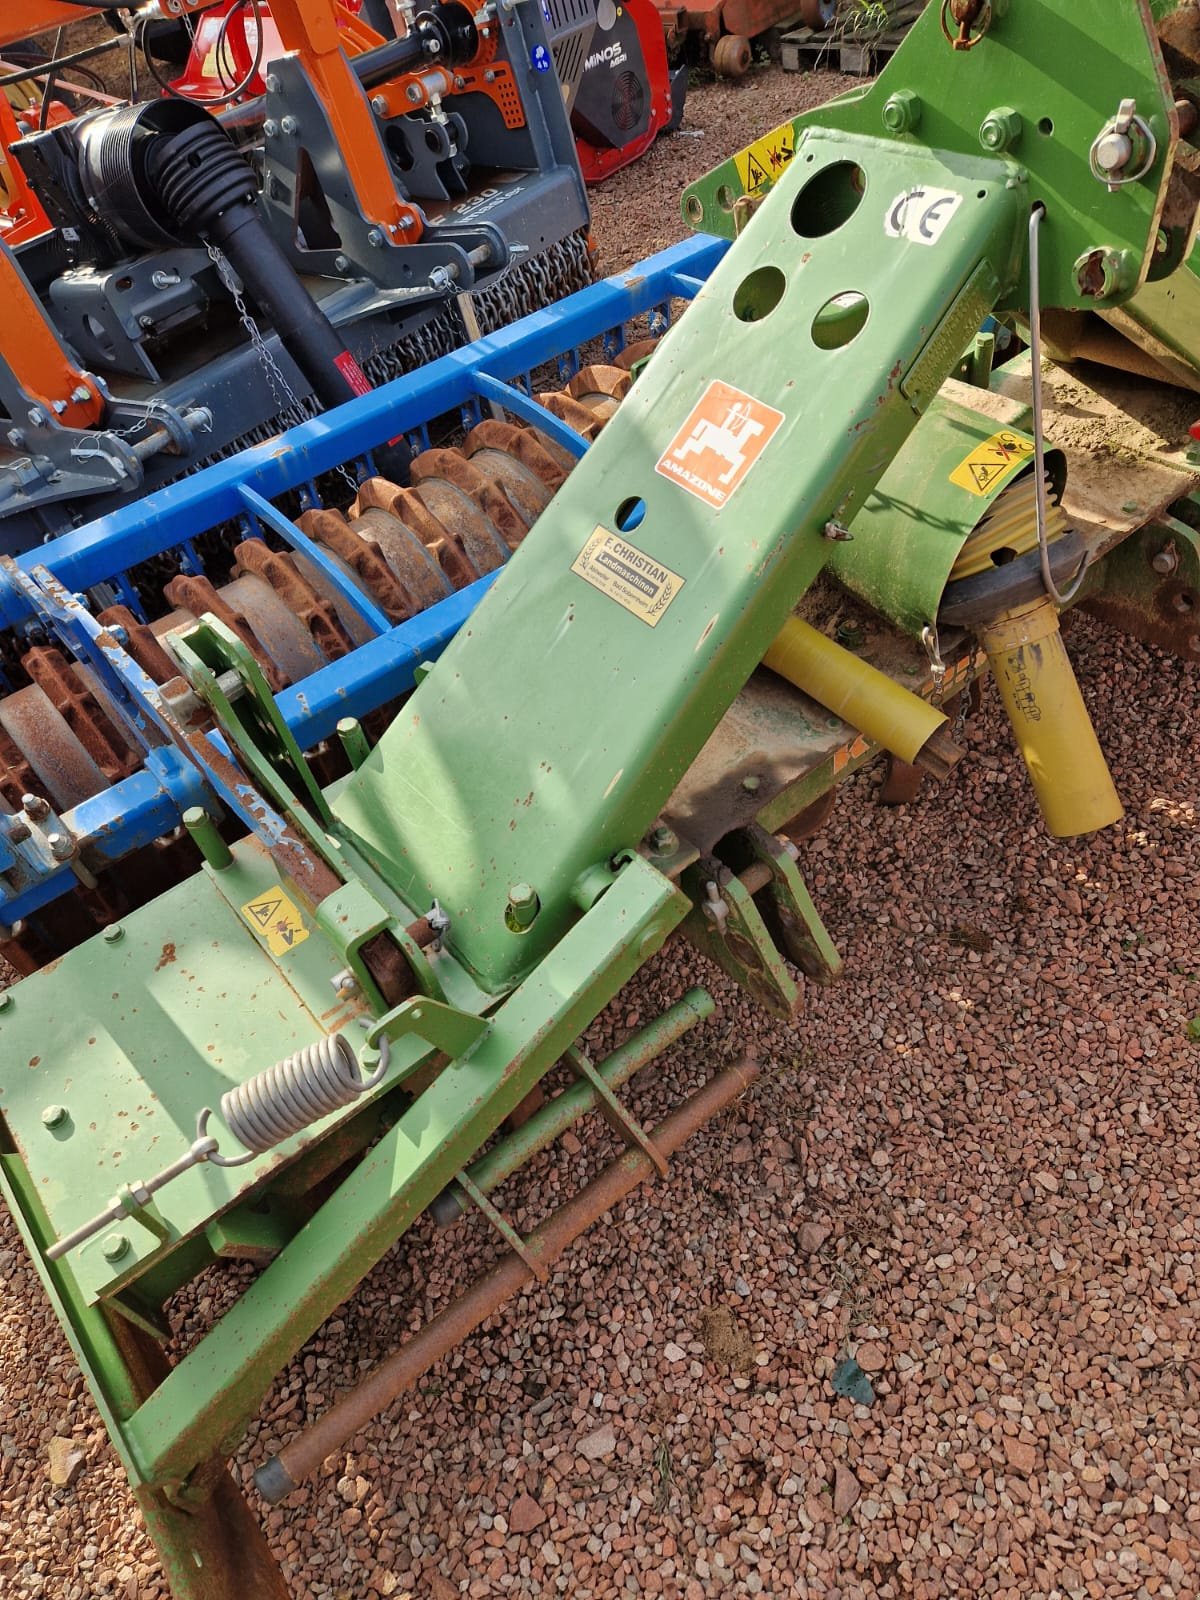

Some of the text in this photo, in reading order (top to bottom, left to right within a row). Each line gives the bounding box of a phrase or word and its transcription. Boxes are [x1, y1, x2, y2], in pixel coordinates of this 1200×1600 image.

[453, 188, 498, 214] 230
[891, 191, 955, 239] CE
[661, 459, 727, 501] AMAZONE
[598, 552, 655, 595] Landmaschinen
[613, 543, 669, 584] CHRISTIAN
